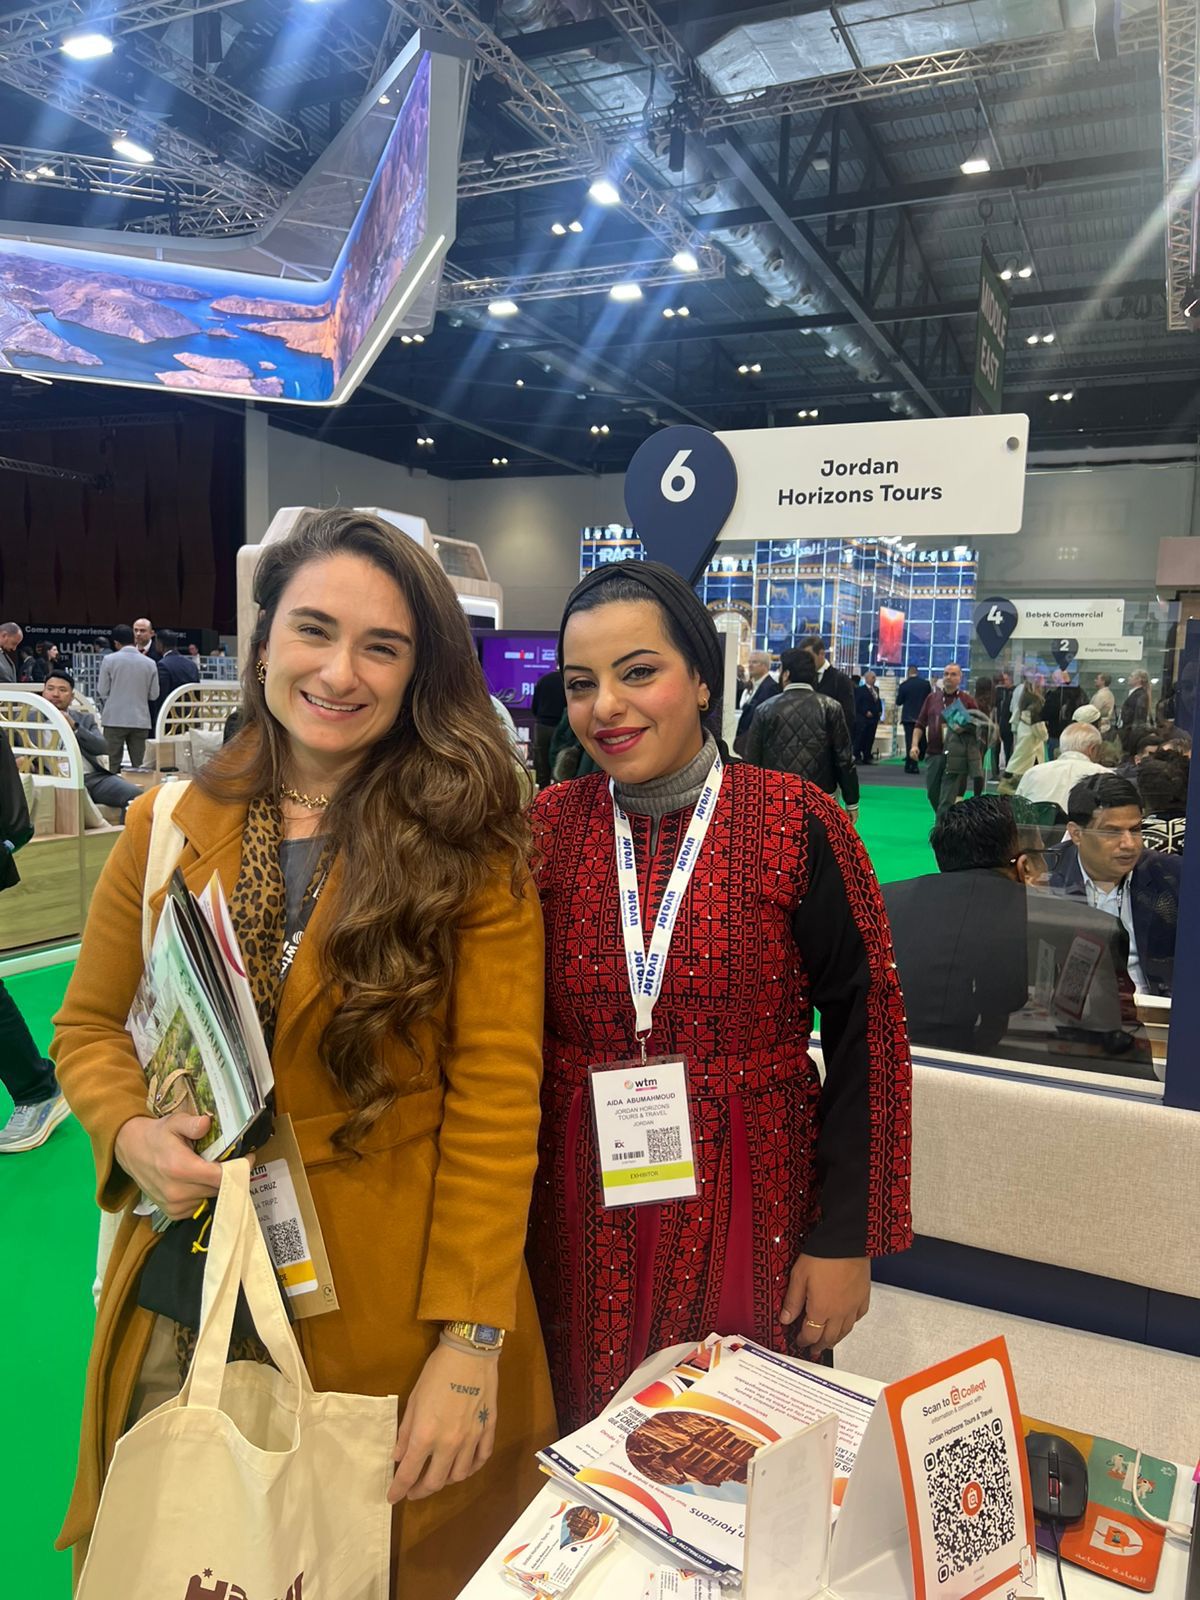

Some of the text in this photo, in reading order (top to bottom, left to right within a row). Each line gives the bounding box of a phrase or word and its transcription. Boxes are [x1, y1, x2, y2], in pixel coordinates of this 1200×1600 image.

[981, 277, 1007, 350] MIDDLE
[981, 336, 999, 391] EAST
[820, 458, 899, 477] Jordan
[660, 449, 696, 502] 6
[778, 483, 943, 506] Horizons Tours
[600, 547, 634, 562] IRAQ
[987, 605, 1003, 625] 4
[1025, 611, 1103, 619] Bebek Commercial
[25, 625, 112, 636] Come and experience
[1051, 620, 1084, 628] Tourism
[1059, 640, 1069, 651] 2
[635, 1078, 657, 1087] wtm
[626, 1093, 675, 1104] ABUMAHMOUD
[615, 1104, 669, 1115] JORDAN HORIZONS
[630, 1171, 658, 1179] EXHIBITOR
[260, 1181, 277, 1193] CRUZ
[450, 1383, 480, 1396] VENUS
[922, 1379, 987, 1417] Scan to Colleqt
[928, 1430, 945, 1445] Jordan
[964, 1416, 976, 1430] Tours
[689, 1507, 735, 1534] Horizons
